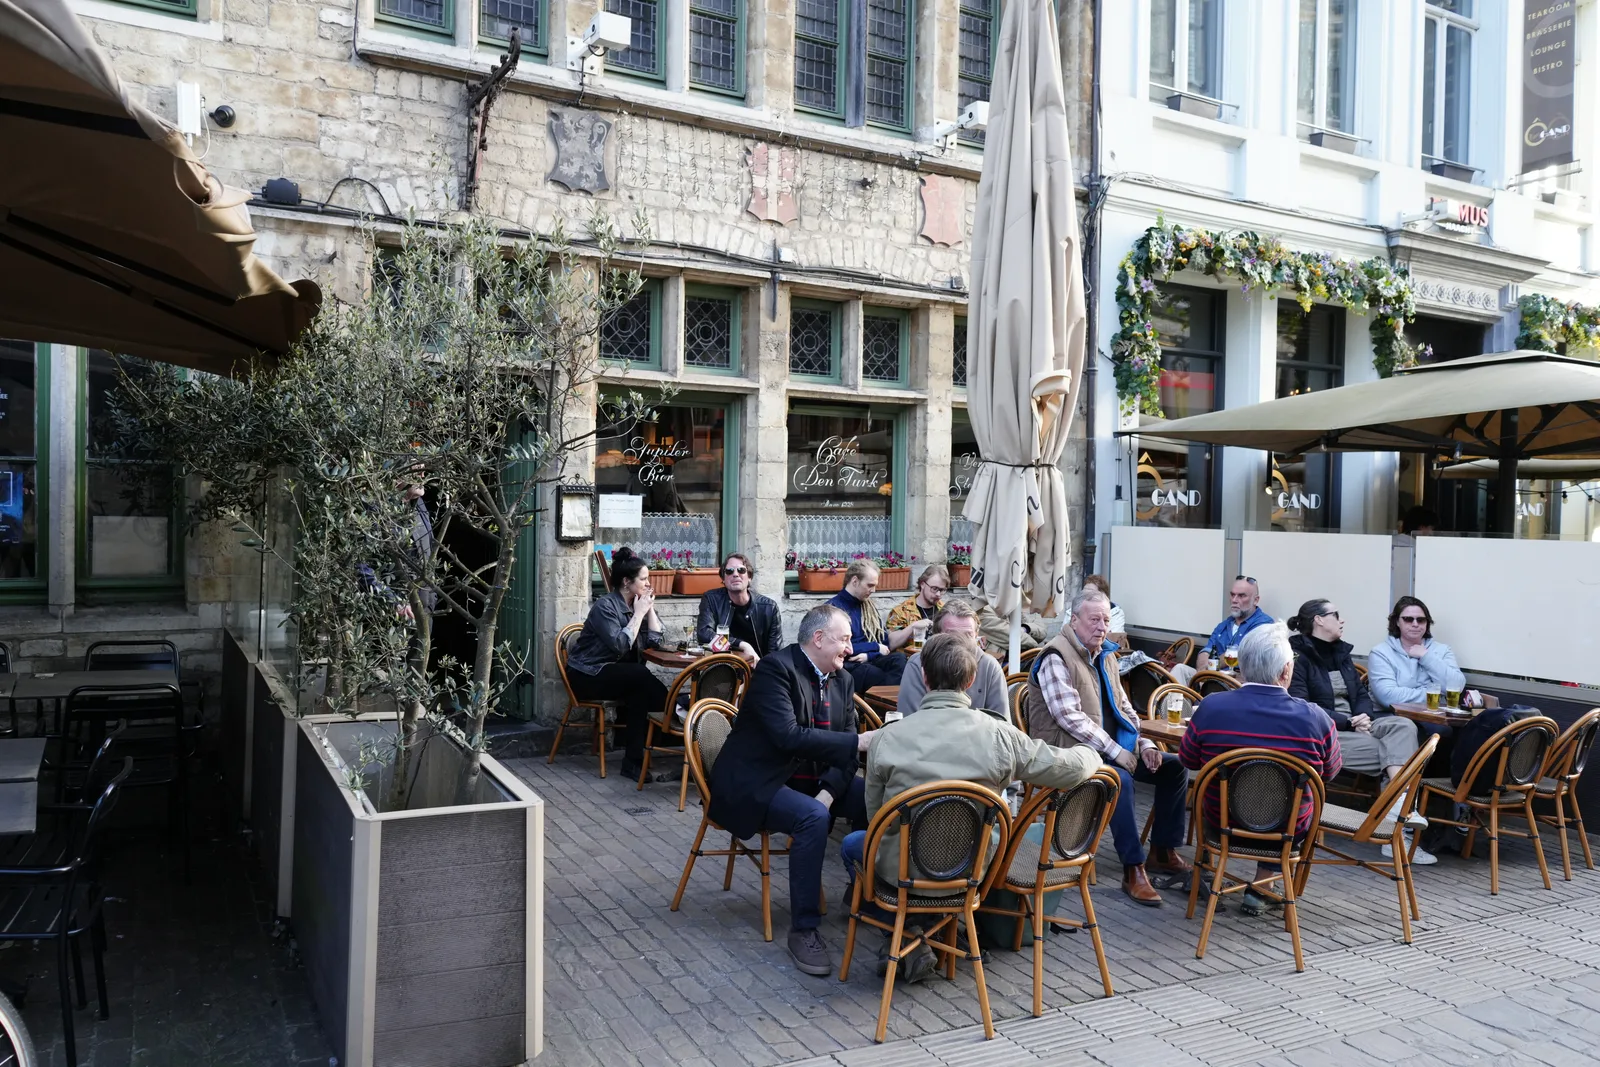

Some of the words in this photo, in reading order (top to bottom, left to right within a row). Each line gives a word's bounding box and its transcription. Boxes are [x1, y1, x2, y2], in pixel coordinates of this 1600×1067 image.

[1528, 1, 1571, 20] TEAROOM
[1526, 19, 1571, 40] BRASSERIE
[1530, 40, 1566, 57] LOUNGE
[1533, 60, 1563, 75] BISTRO
[959, 452, 984, 470] Ver
[638, 464, 675, 486] Bier
[793, 464, 834, 493] Den
[838, 466, 888, 488] Turk
[1151, 488, 1201, 514] GAND
[1278, 492, 1321, 516] GAND
